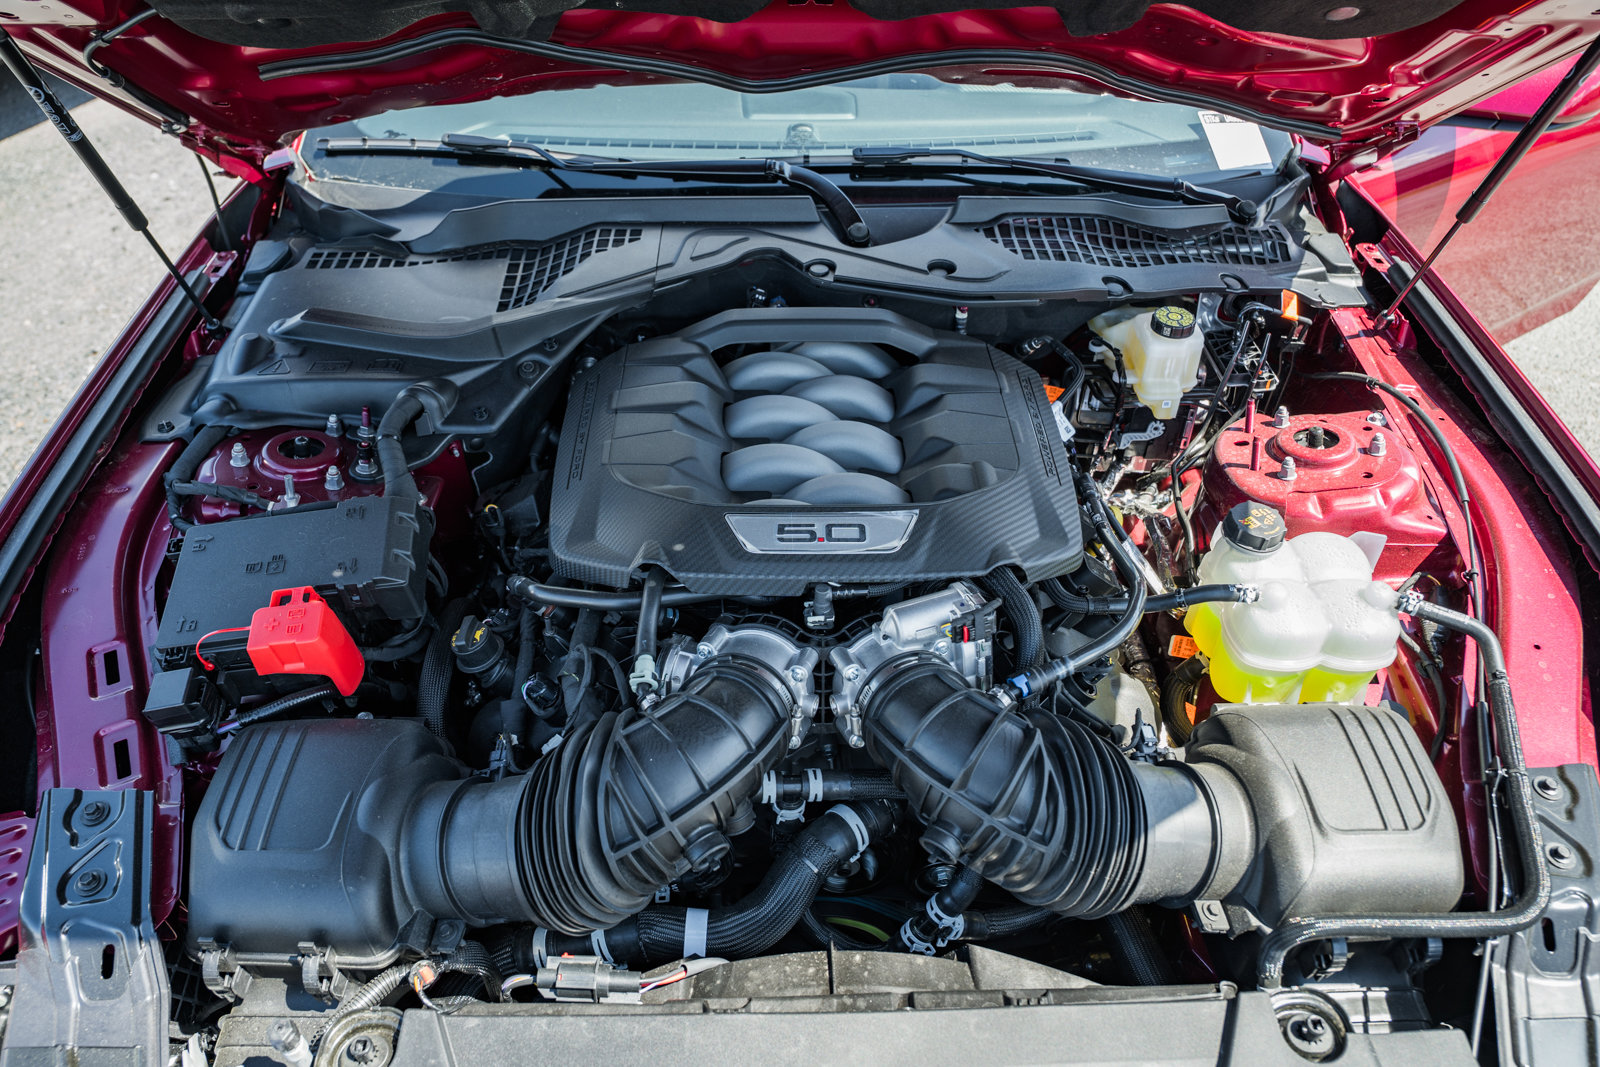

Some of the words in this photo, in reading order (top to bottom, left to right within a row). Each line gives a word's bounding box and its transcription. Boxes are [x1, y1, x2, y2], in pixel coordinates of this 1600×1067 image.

[1021, 375, 1034, 403] FORD
[1029, 405, 1039, 419] BY
[1035, 423, 1056, 476] POWERED
[572, 449, 583, 479] FORD
[776, 523, 867, 543] 5.0
